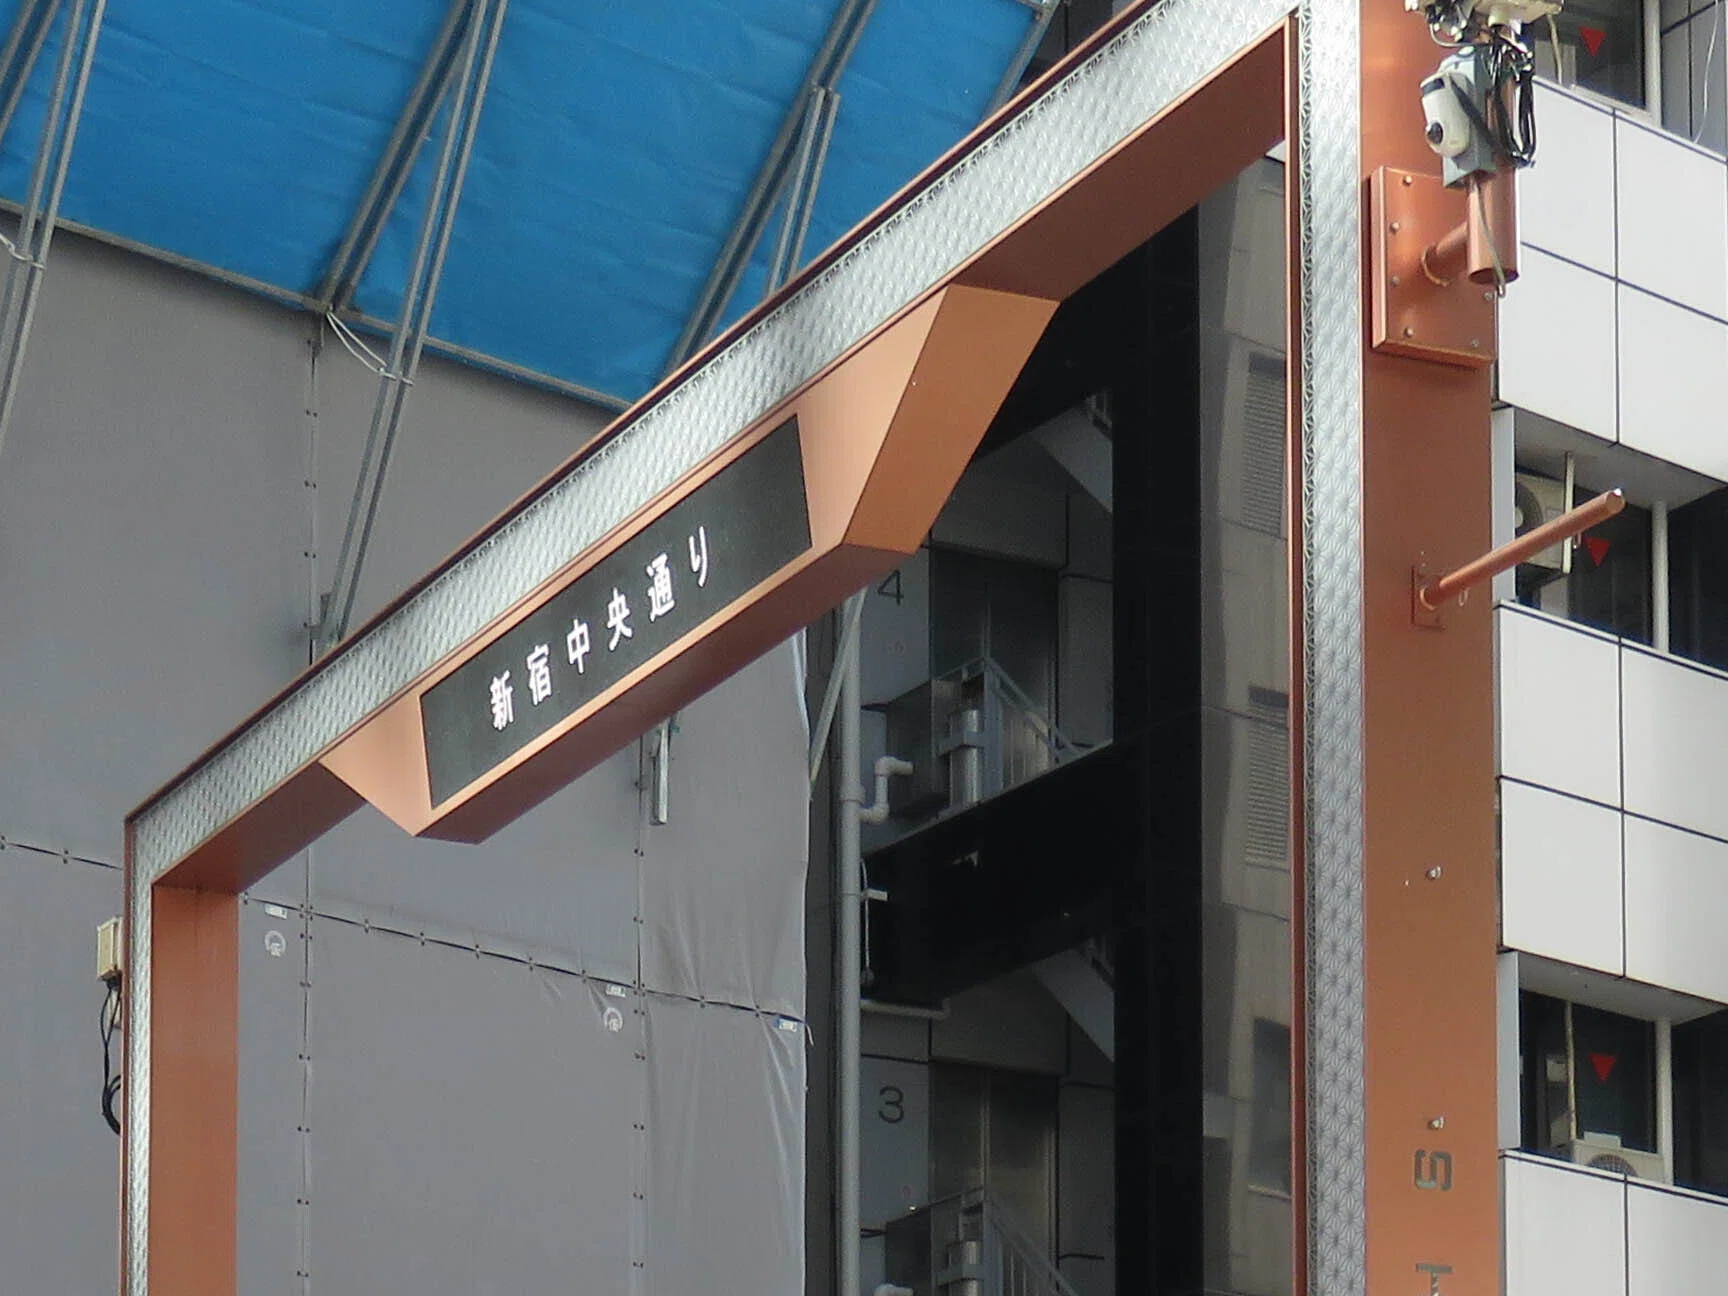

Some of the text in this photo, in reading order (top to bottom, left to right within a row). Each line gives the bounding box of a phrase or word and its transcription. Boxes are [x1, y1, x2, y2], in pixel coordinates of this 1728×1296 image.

[876, 569, 904, 607] 4
[490, 526, 709, 731] 新宿中央通り
[877, 1085, 905, 1125] 3
